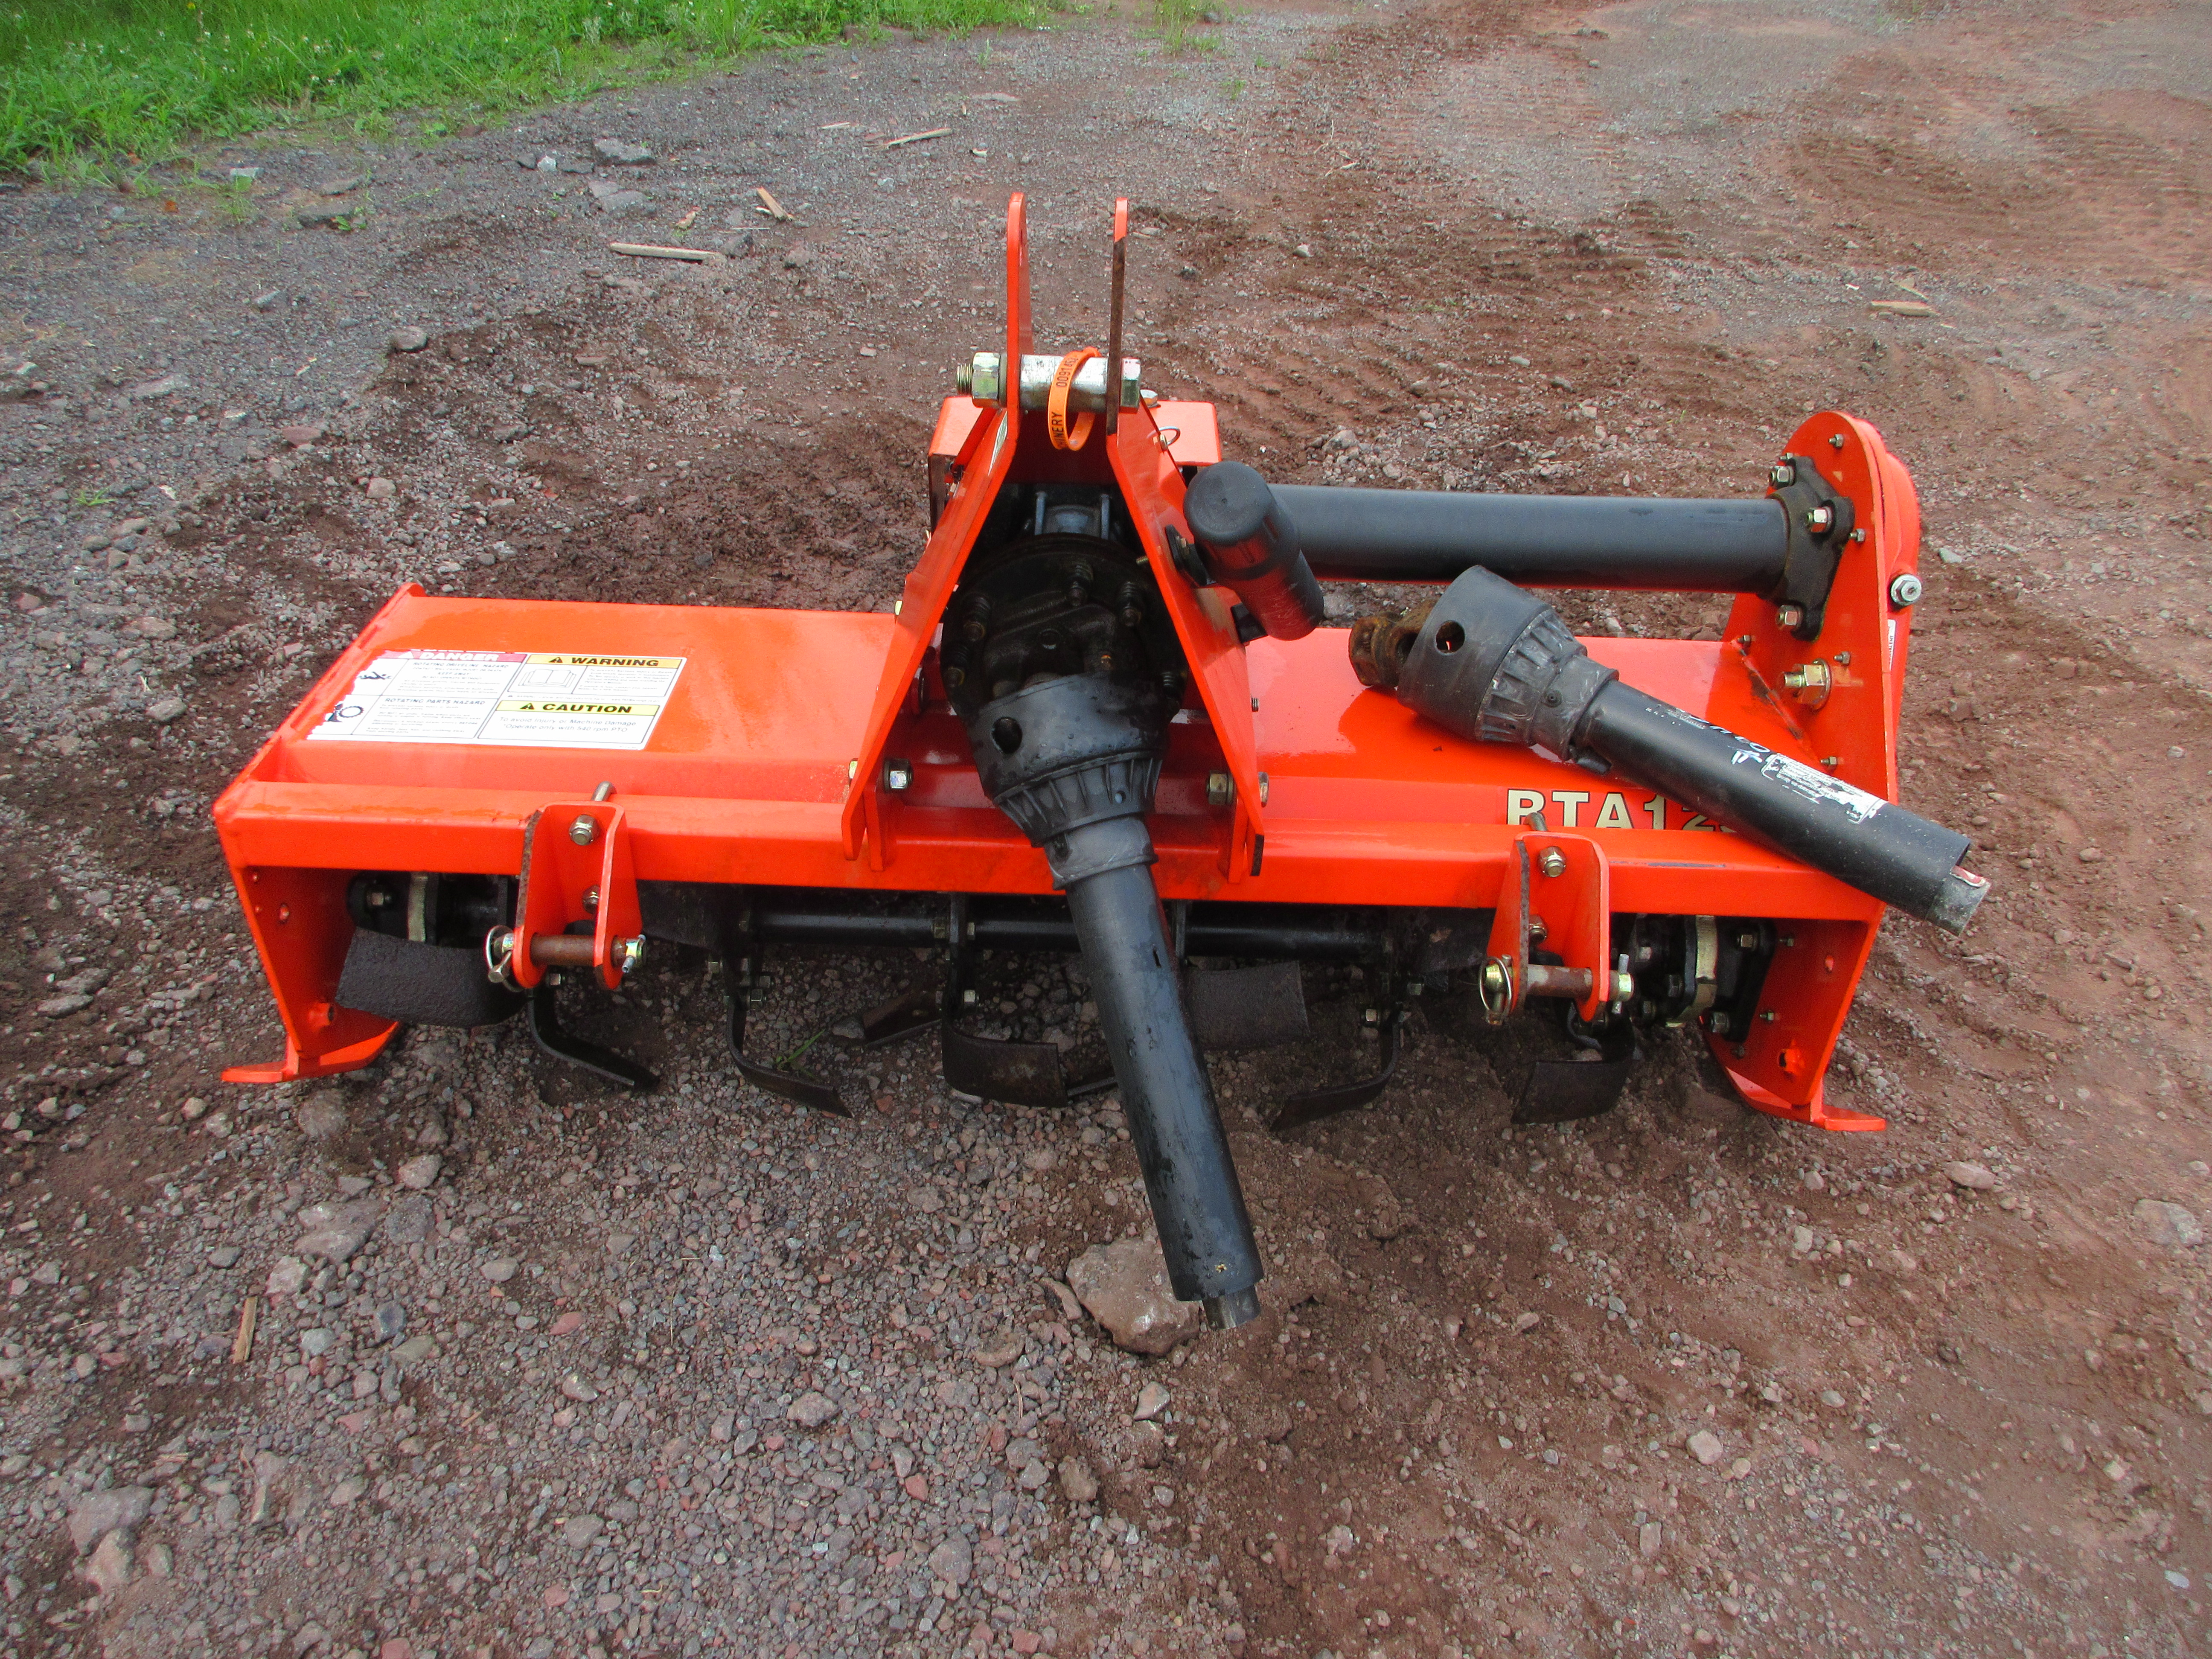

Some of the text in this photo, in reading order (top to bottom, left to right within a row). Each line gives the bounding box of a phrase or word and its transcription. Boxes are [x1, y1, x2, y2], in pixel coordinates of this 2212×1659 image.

[419, 652, 499, 661] DANGER
[570, 657, 659, 667] WARNING
[542, 704, 632, 713] CAUTION
[1507, 789, 1738, 833] RTA12
